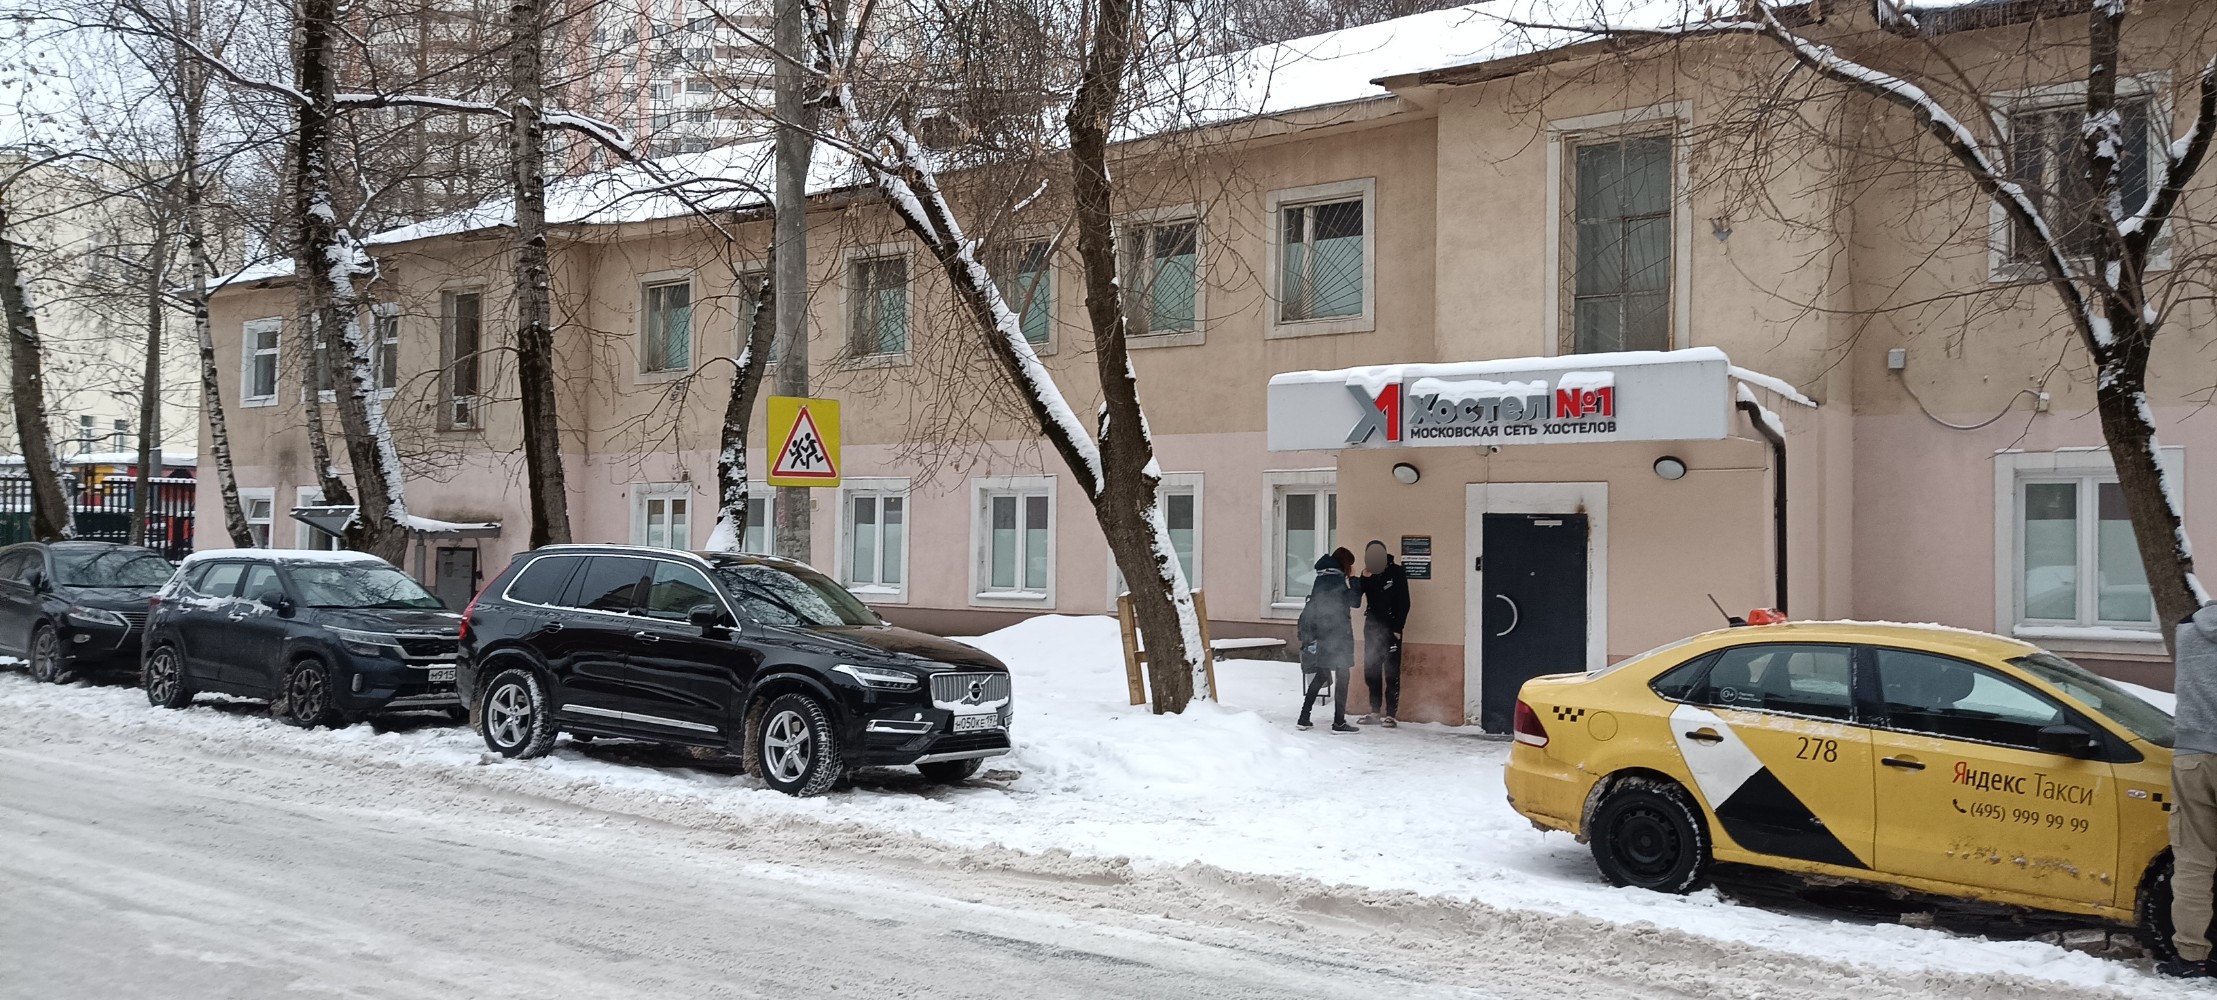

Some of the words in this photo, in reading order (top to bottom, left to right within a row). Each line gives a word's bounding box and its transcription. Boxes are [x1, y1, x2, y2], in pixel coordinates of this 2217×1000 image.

[1409, 392, 1550, 424] Хостел
[1556, 386, 1616, 418] №1
[1410, 425, 1498, 439] МОСКОВСКАЯ
[1504, 423, 1538, 437] СЕТЬ
[1543, 421, 1617, 435] ХОСТЕЛОВ
[1796, 736, 1838, 763] 278
[1952, 761, 2027, 795] Яндекс
[2034, 772, 2094, 806] Такси
[1970, 802, 2006, 822] (495)
[2013, 808, 2039, 826] 999
[2046, 814, 2064, 830] 99
[2070, 818, 2089, 834] 99
